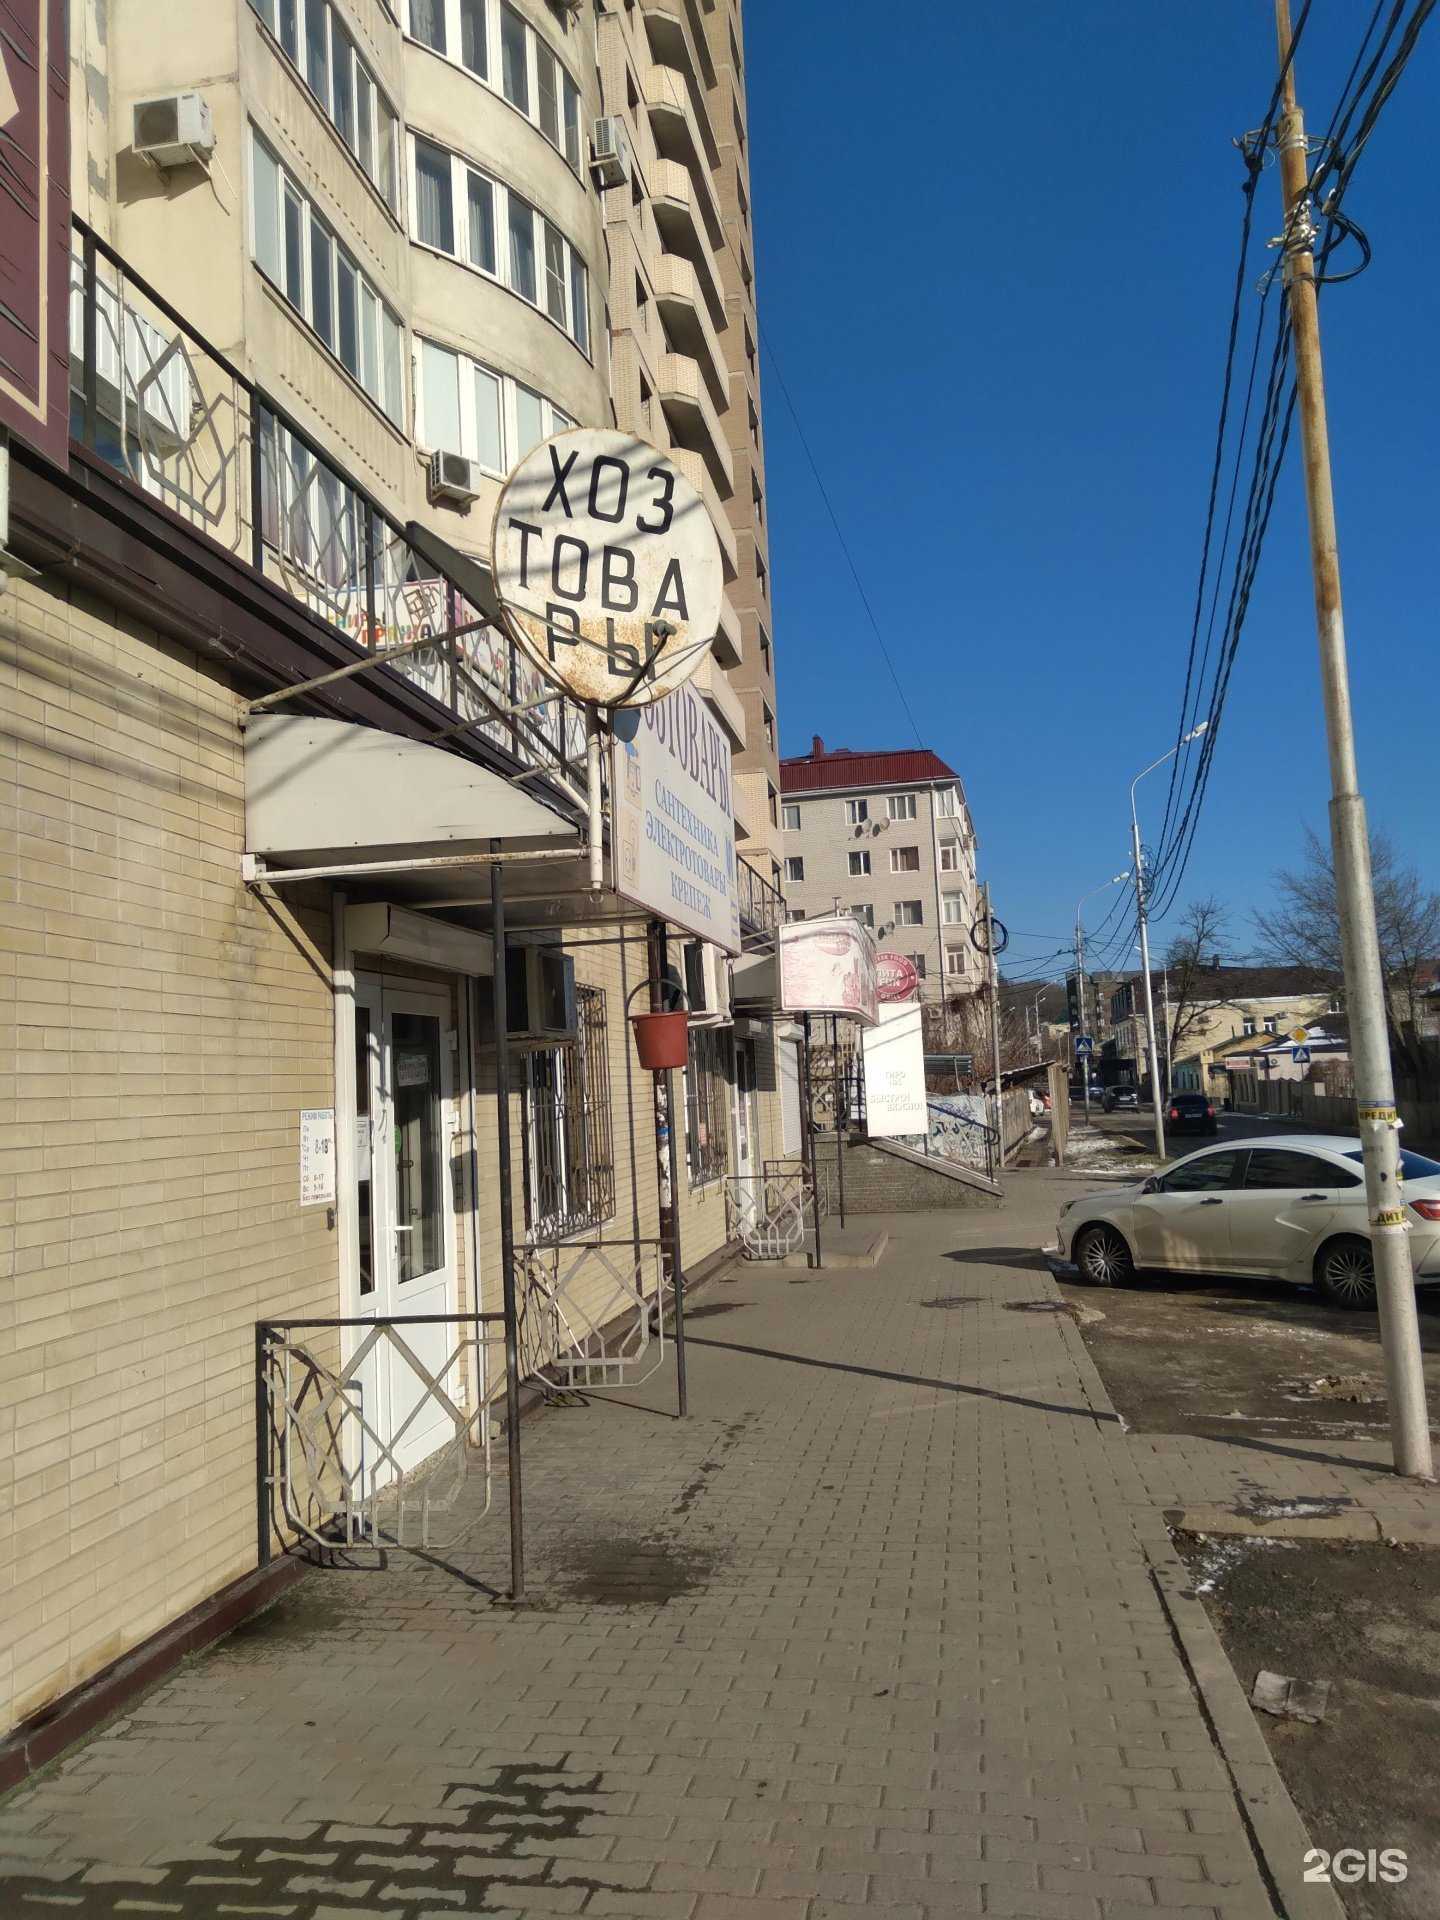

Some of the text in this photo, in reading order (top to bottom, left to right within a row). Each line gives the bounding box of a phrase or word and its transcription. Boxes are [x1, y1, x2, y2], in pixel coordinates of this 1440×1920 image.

[541, 444, 675, 535] ХОЗ
[508, 517, 690, 621] ТОВА
[546, 601, 657, 680] РЫ
[645, 809, 727, 896] ЭЛЕКТРОТОВАРЫ
[655, 778, 719, 857] САНТЕХНИКА
[671, 871, 711, 920] КРЕПЕЖ
